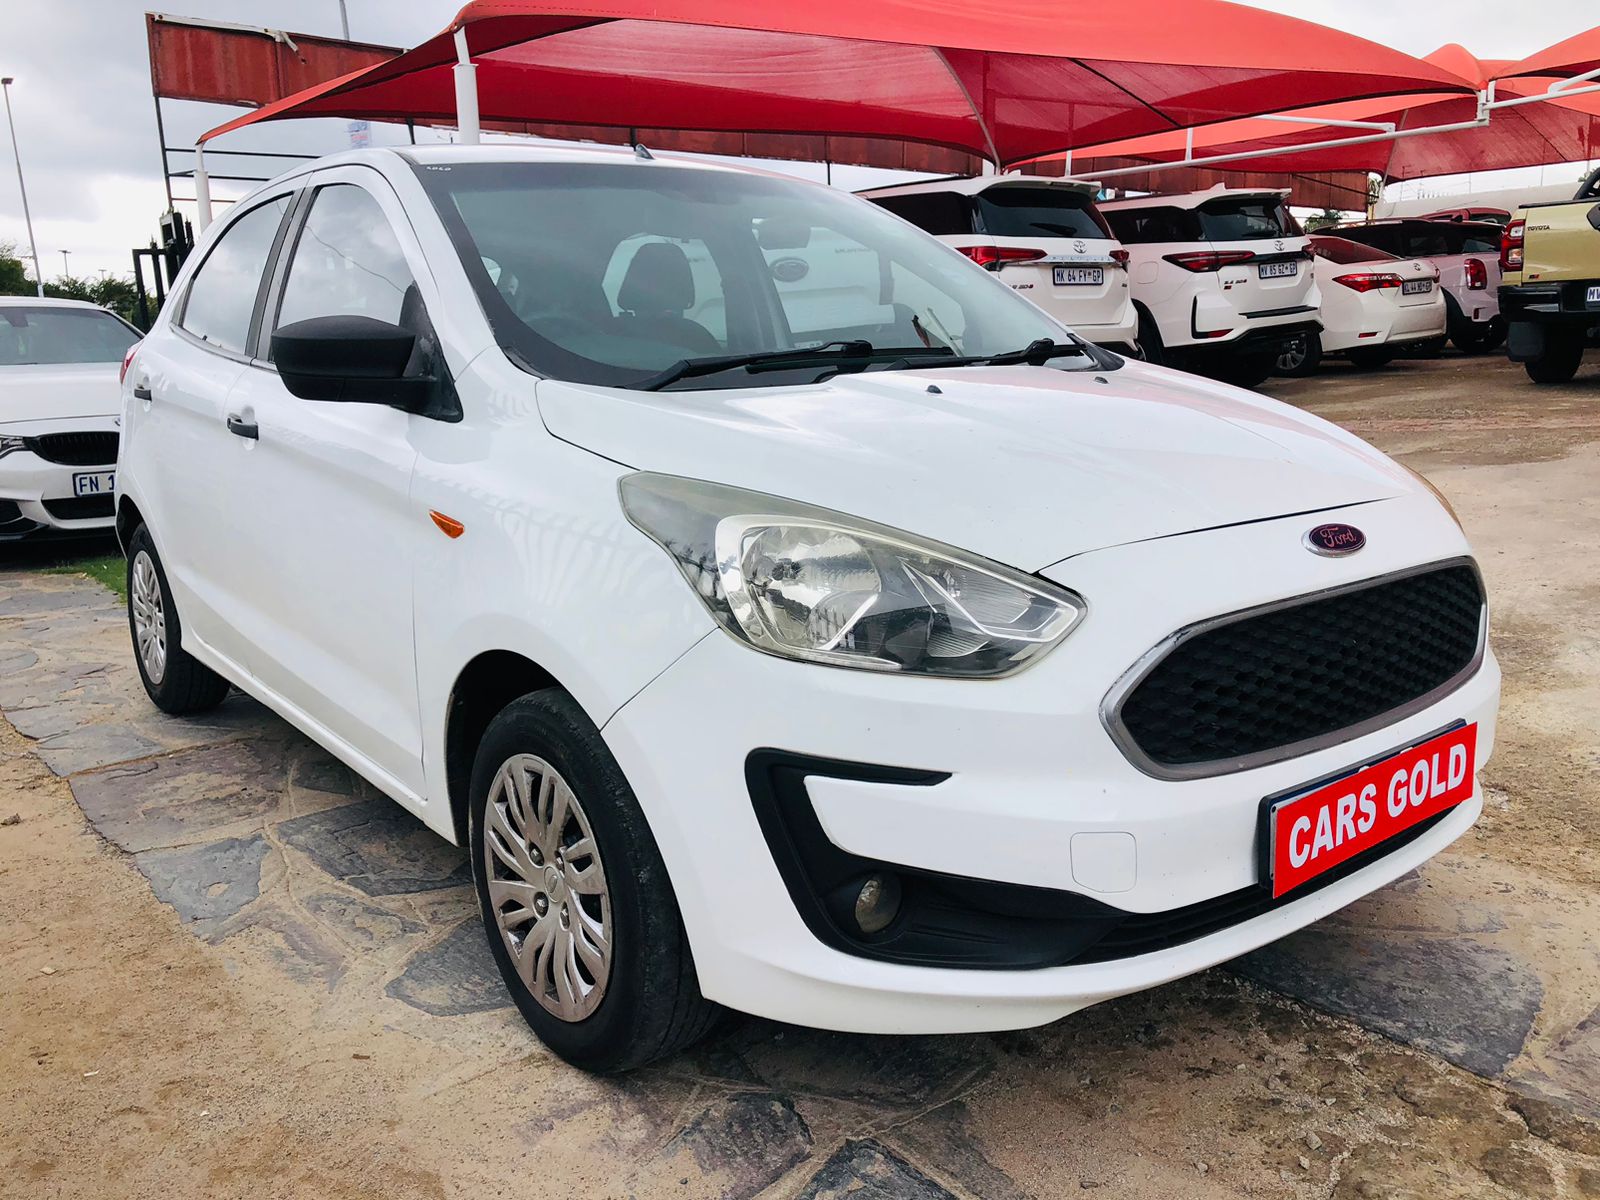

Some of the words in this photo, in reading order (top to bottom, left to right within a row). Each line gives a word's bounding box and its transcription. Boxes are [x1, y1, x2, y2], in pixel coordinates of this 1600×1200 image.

[1056, 269, 1065, 282] MK
[1068, 269, 1076, 282] 64
[1092, 269, 1101, 282] GP
[79, 476, 99, 493] FN
[1320, 527, 1357, 547] Ford
[1289, 783, 1377, 869] CARS
[1387, 743, 1467, 818] GOLD
